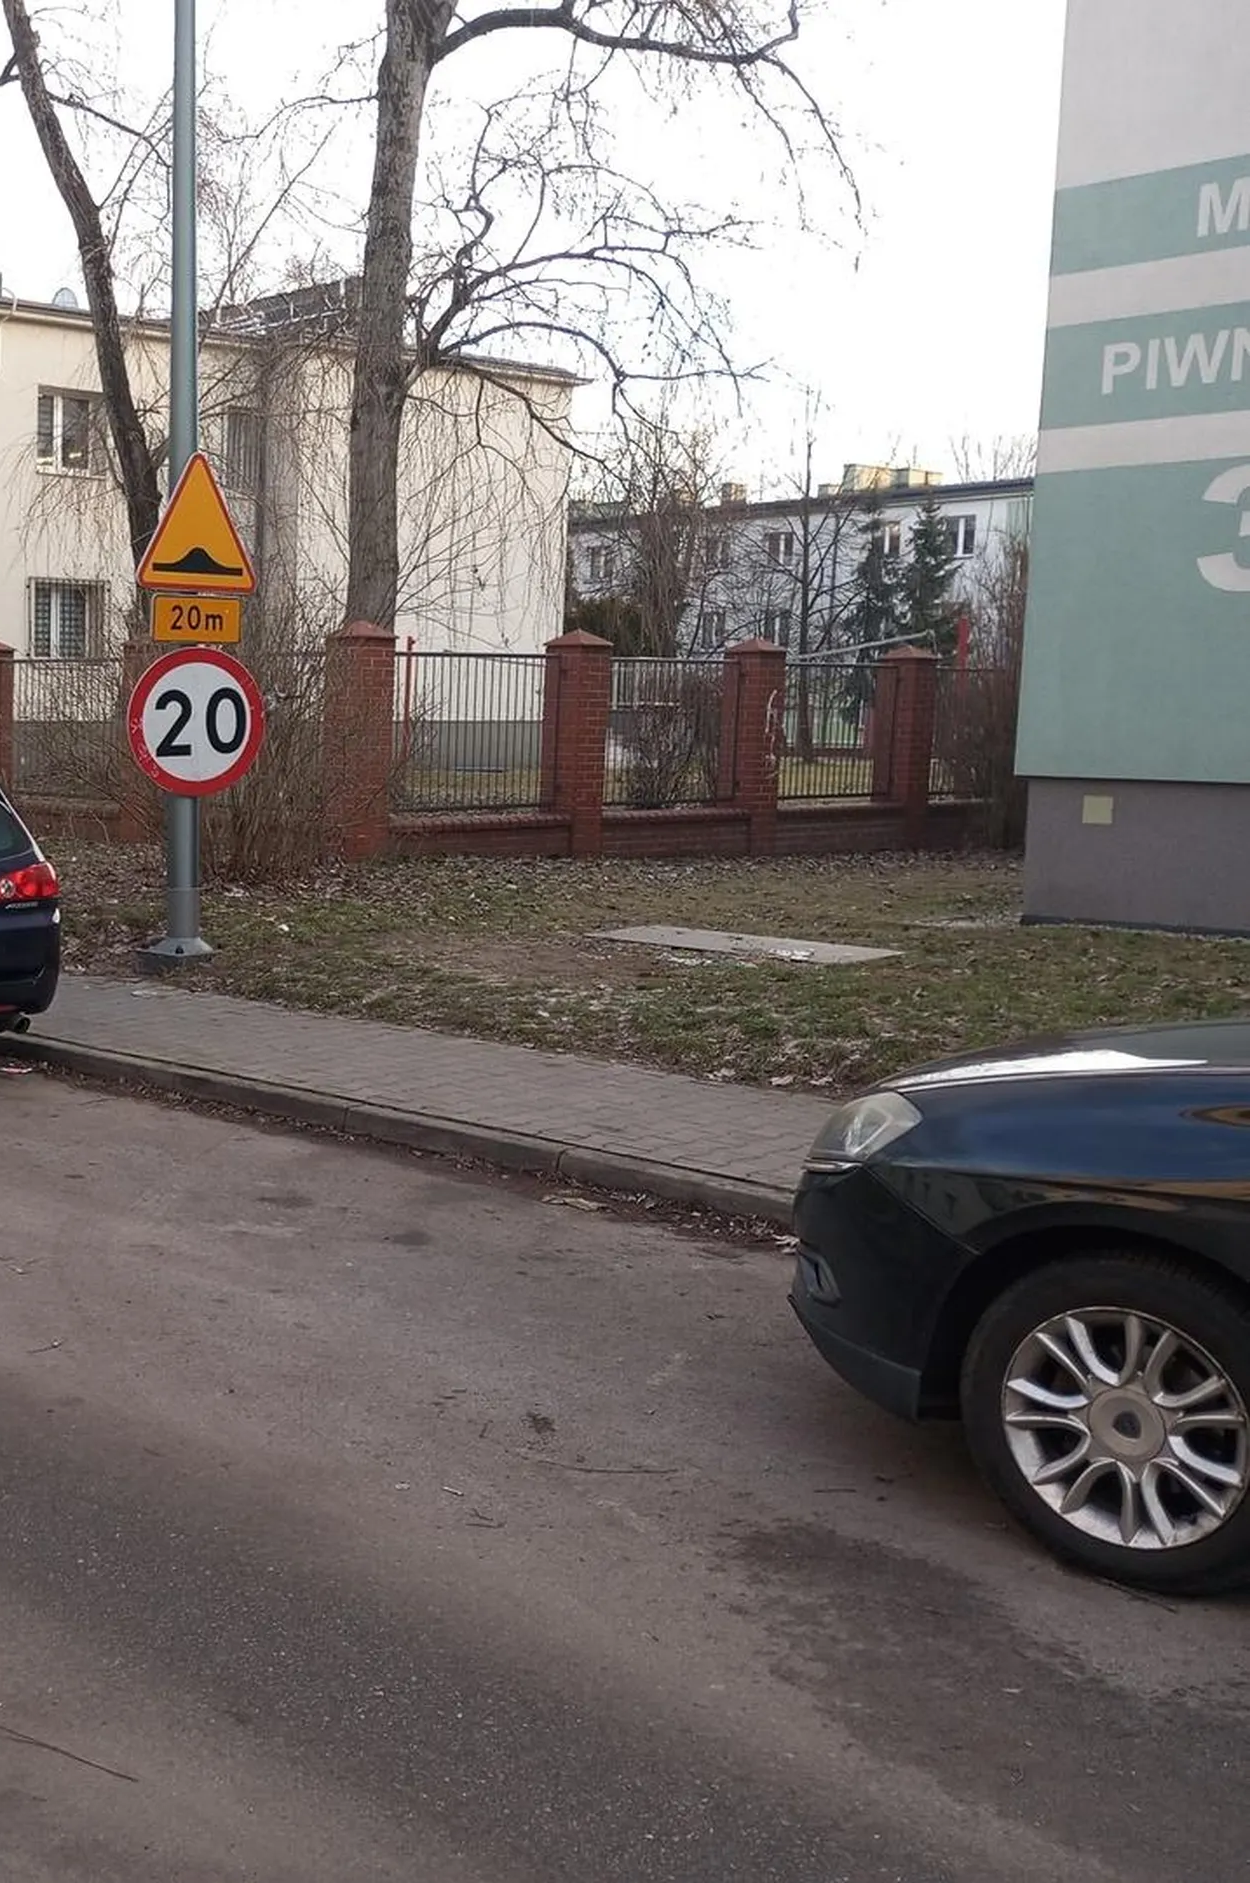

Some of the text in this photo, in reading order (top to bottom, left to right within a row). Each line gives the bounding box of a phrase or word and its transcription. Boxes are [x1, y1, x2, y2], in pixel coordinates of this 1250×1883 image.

[1197, 176, 1250, 237] M
[170, 605, 223, 631] 20m
[155, 687, 247, 757] 20
